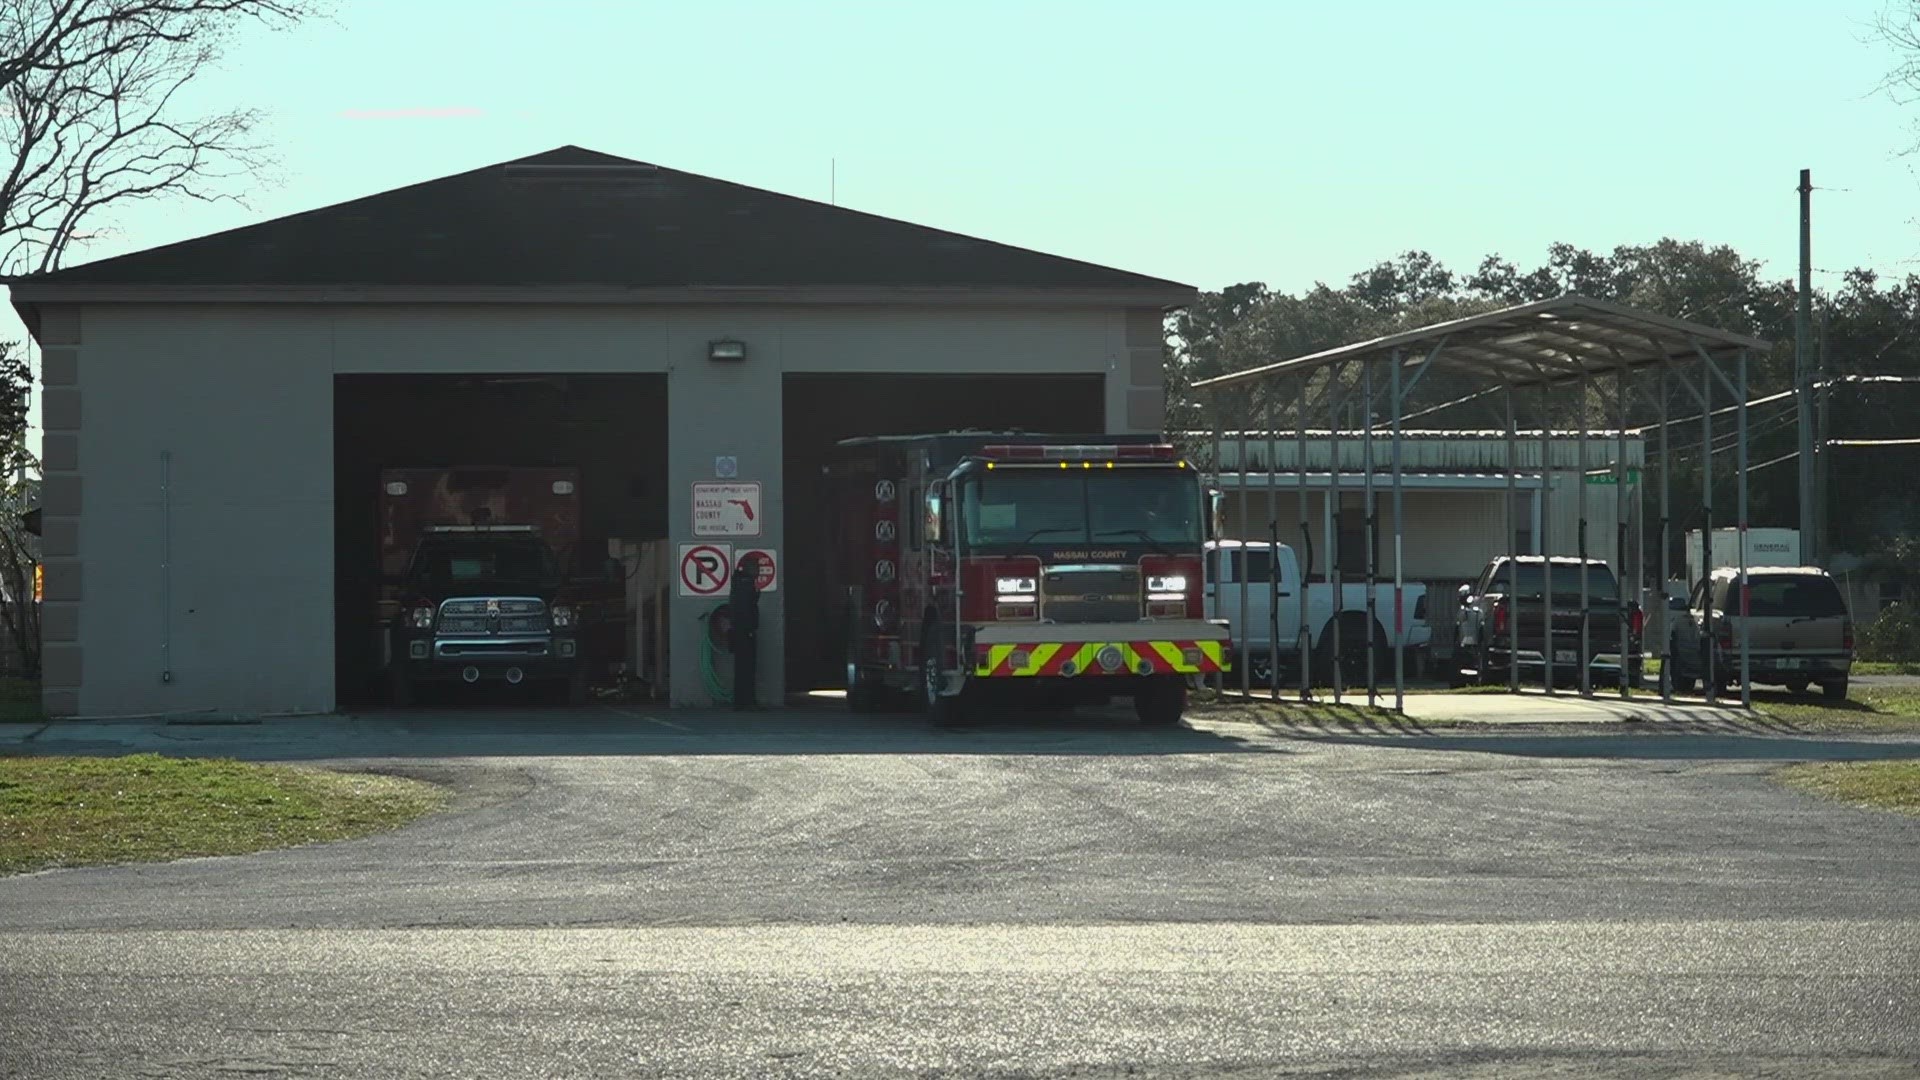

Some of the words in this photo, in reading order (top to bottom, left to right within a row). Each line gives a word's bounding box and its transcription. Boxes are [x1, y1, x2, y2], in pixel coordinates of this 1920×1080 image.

[696, 500, 722, 508] NASSAU
[696, 511, 721, 520] COUNTY
[1053, 551, 1088, 559] NASSAU
[1091, 550, 1127, 559] COUNTY
